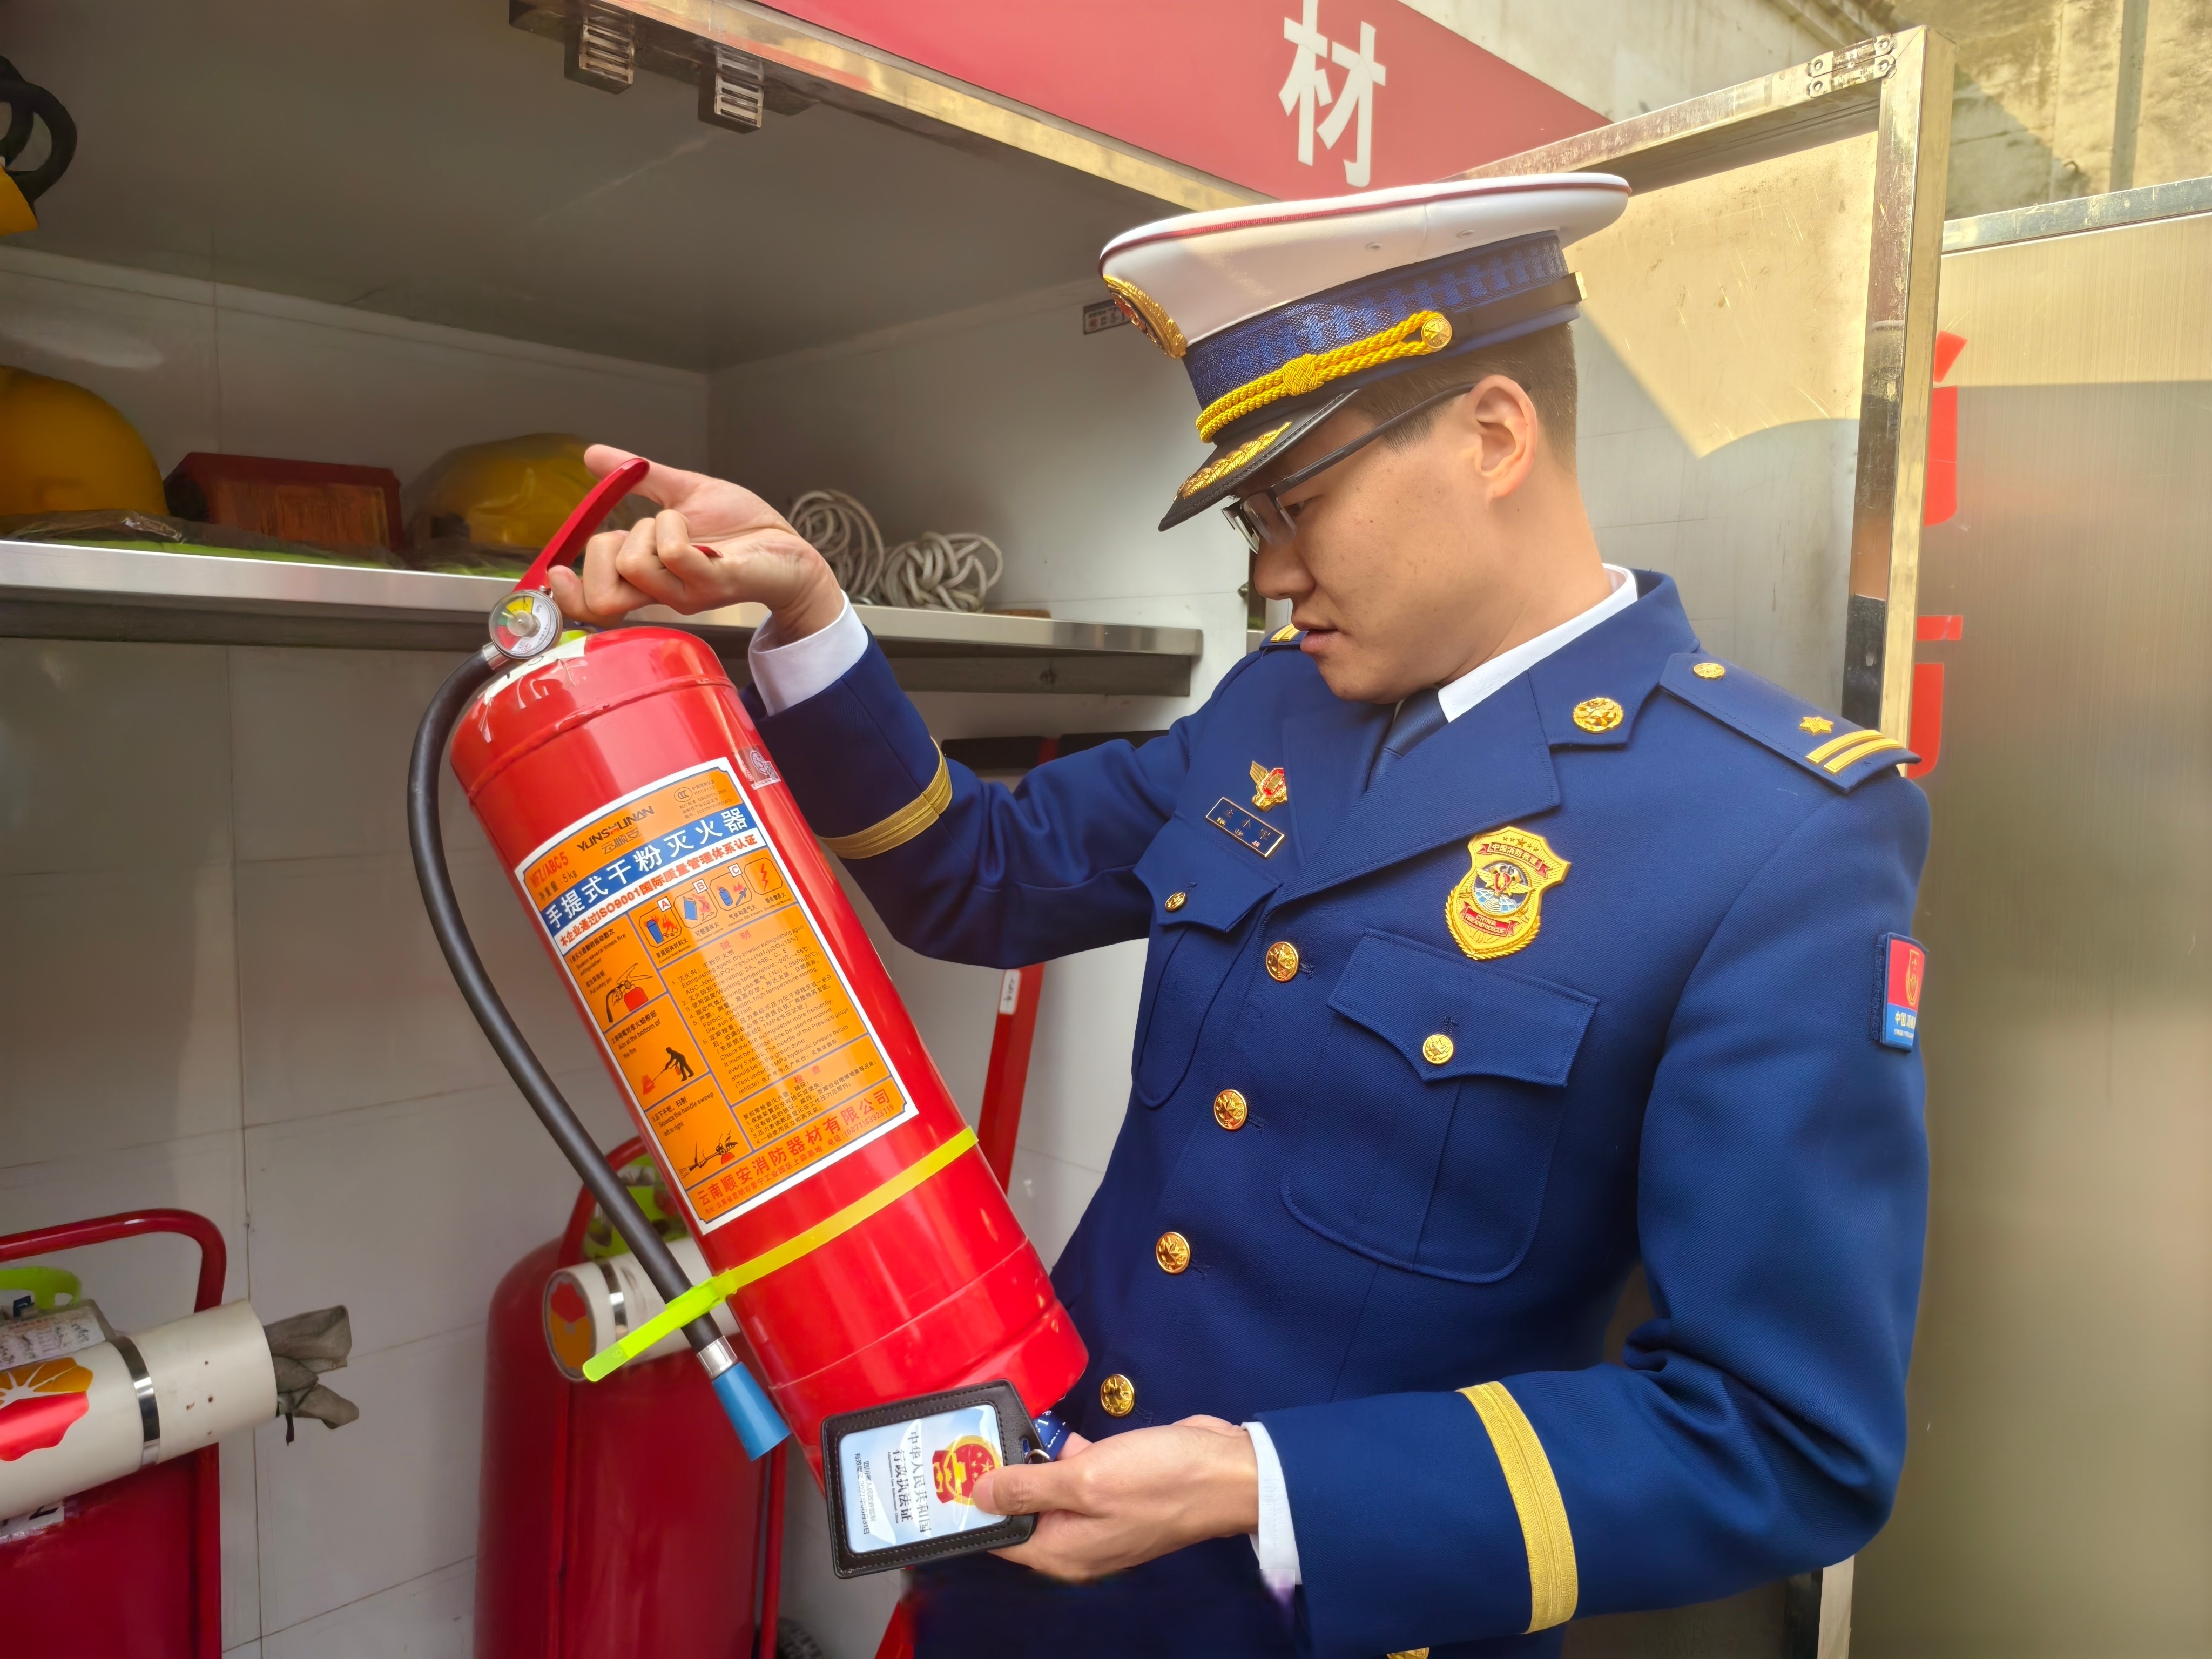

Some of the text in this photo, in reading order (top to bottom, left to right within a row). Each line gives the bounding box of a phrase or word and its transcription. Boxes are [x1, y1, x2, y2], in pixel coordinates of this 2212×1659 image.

[1278, 0, 1386, 187] 材
[599, 825, 641, 855] 云顺安
[1492, 844, 1539, 865] 中国消防救援
[545, 807, 750, 932] 手提式干粉灭火器
[696, 881, 705, 890] B
[731, 866, 739, 874] C
[559, 834, 758, 948] 本企业通过ISO9001国际质量管理体系认证
[659, 899, 669, 909] A
[694, 921, 719, 937] 可燃液体火
[728, 904, 757, 920] 气体和蒸气火
[1465, 915, 1505, 933] FIRE AND RESCUE
[1476, 915, 1495, 926] CHINA
[617, 932, 626, 941] fire
[682, 925, 805, 989] Extinguishing agent: dry powder extinguishing agent
[725, 968, 745, 982] rating:
[724, 998, 753, 1016] inversion,
[752, 992, 766, 1001] high
[765, 975, 799, 995] temperature
[637, 1022, 655, 1037] bottom
[717, 1019, 729, 1027] sun
[729, 1012, 740, 1021] and
[740, 1006, 752, 1015] rain
[720, 1048, 738, 1060] Check
[738, 1042, 747, 1050] the
[748, 1036, 758, 1045] fire
[758, 1019, 792, 1040] extinguisher
[792, 1011, 807, 1021] more
[729, 1054, 743, 1064] must
[771, 1032, 785, 1041] once
[793, 1020, 807, 1030] used
[812, 1007, 832, 1020] expired
[727, 1062, 744, 1075] every
[778, 1034, 796, 1046] needle
[811, 1015, 835, 1028] Pressure
[834, 1008, 849, 1017] gauge
[731, 1068, 750, 1081] should
[764, 1054, 773, 1062] the
[774, 1046, 791, 1058] green
[791, 1038, 805, 1048] zone
[734, 1076, 750, 1088] (Test
[787, 1042, 813, 1059] hydraulic
[832, 1024, 848, 1035] before
[659, 1091, 714, 1129] Squeeze the handle sweep
[673, 1120, 684, 1131] right
[697, 1088, 891, 1206] 云南顺安消防器材有限公司
[864, 1461, 876, 1521] 四川省人民政府监制
[893, 1449, 913, 1522] 行政执法证
[908, 1432, 931, 1532] 中华人民共和国
